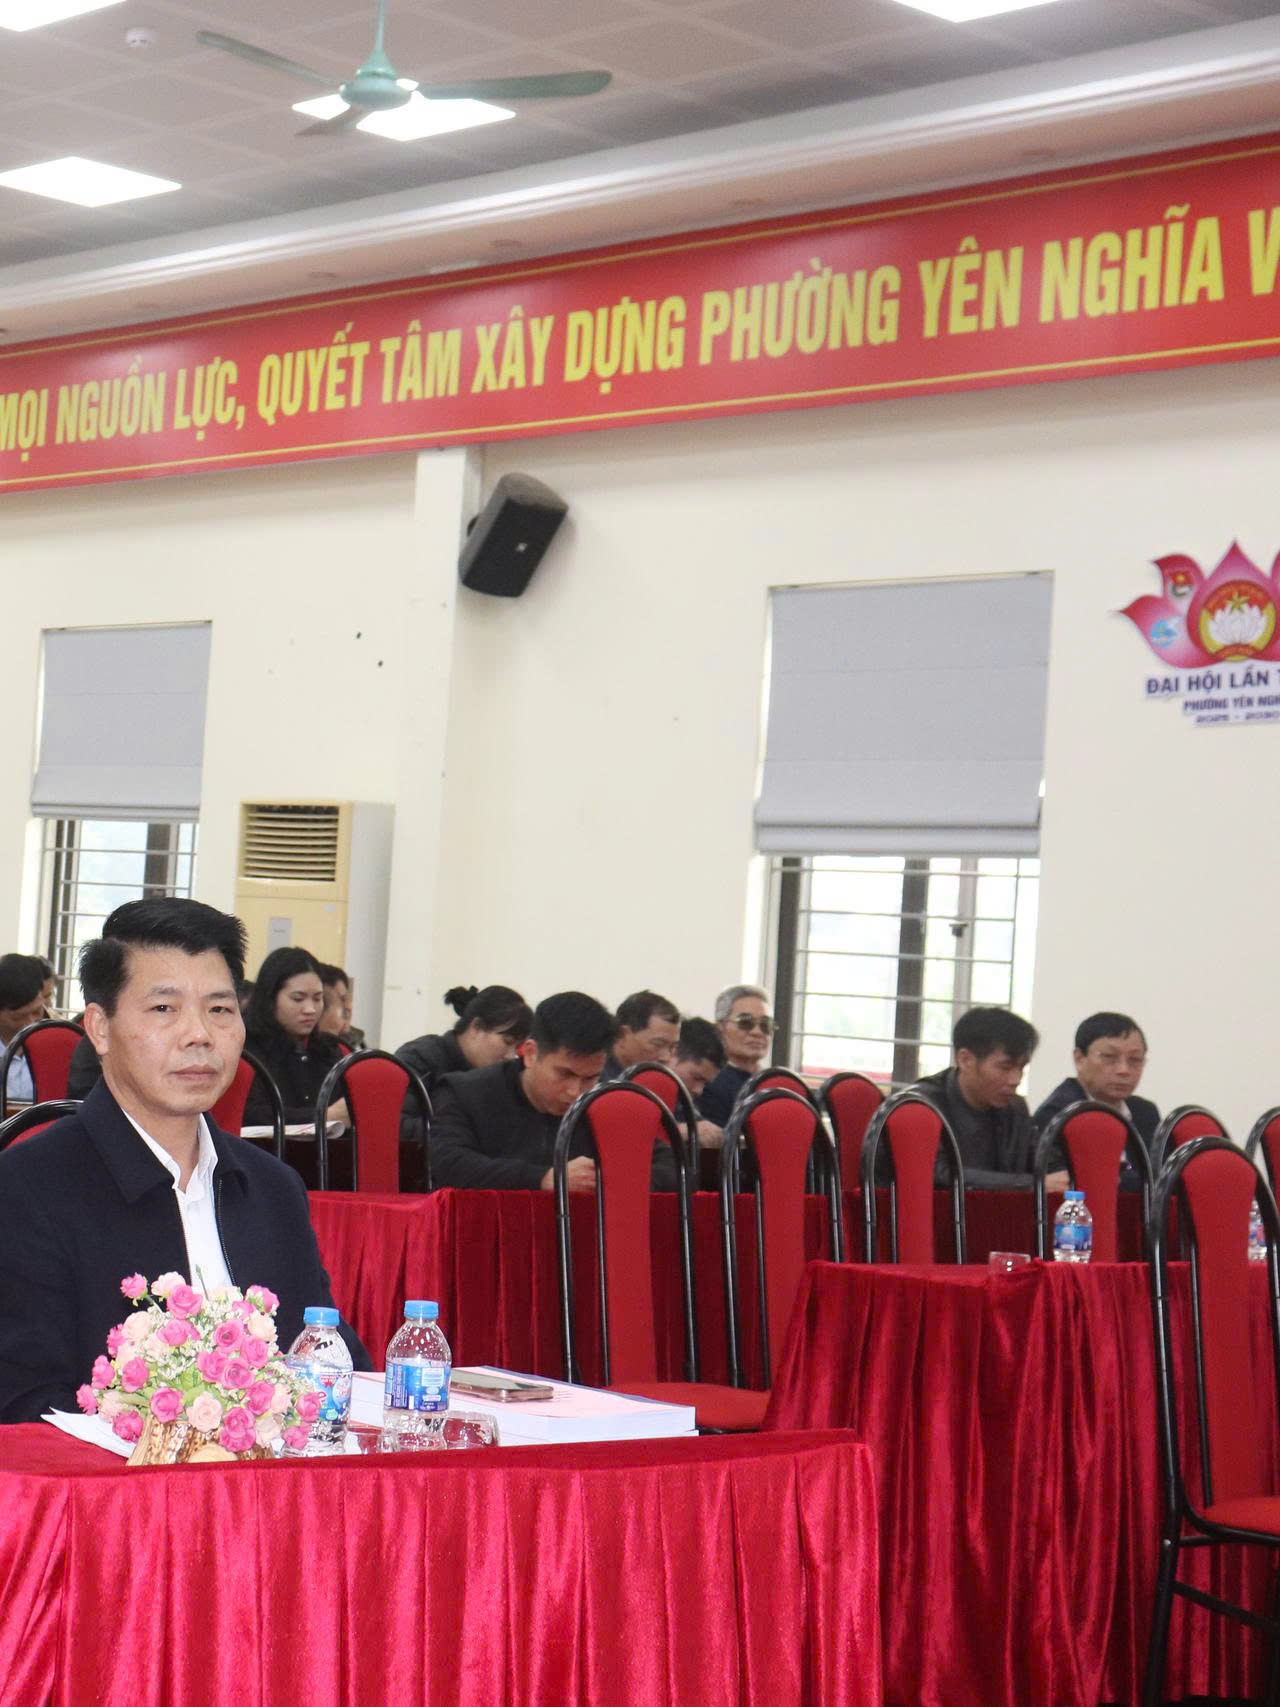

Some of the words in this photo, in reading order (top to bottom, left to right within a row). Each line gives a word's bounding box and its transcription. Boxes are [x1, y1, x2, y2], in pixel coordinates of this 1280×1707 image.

[55, 354, 167, 445] NGUỒN
[173, 355, 246, 441] LỰC,
[256, 322, 371, 427] QUYẾT
[379, 319, 463, 405] TÂM
[471, 305, 556, 395] XÂY
[563, 295, 687, 395] DỰNG
[698, 256, 902, 367] PHƯỜNG
[919, 236, 1025, 339] YÊN
[1039, 203, 1225, 324] NGHĨA
[1147, 676, 1180, 695] ĐẠI
[1188, 670, 1222, 693] HỘI
